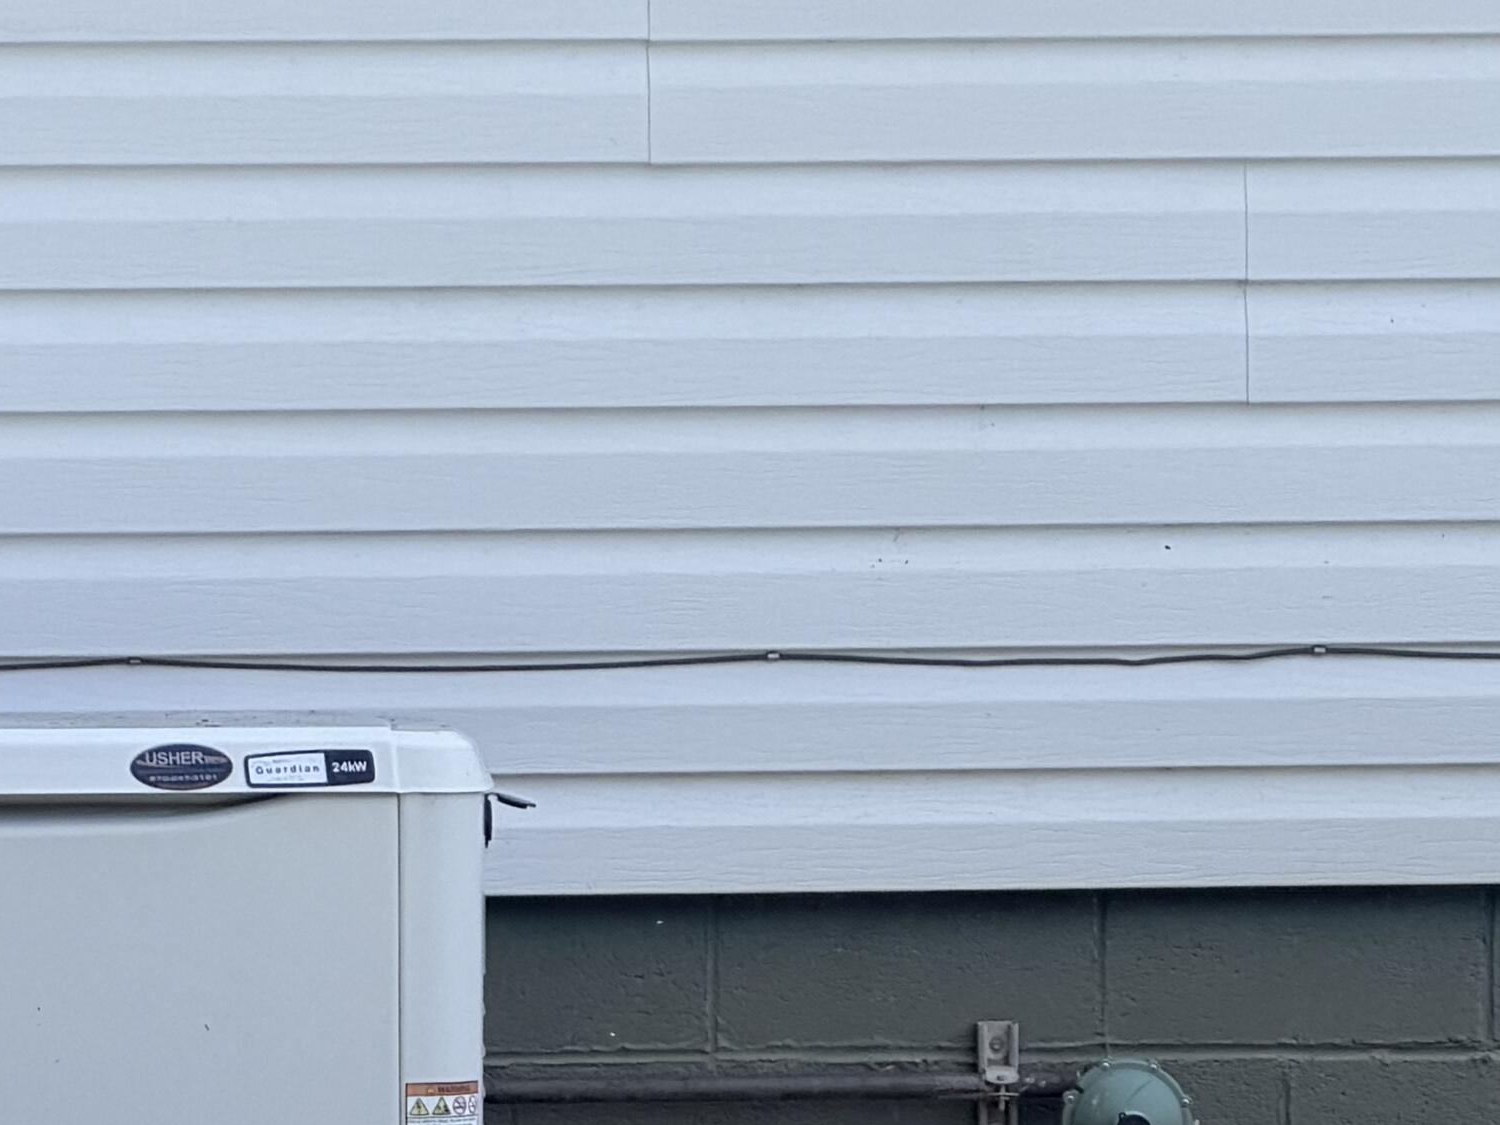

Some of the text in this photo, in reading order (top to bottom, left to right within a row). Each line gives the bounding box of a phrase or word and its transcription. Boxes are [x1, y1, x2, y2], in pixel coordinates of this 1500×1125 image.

[145, 751, 204, 765] USHER
[255, 760, 367, 774] Guardian 24kW
